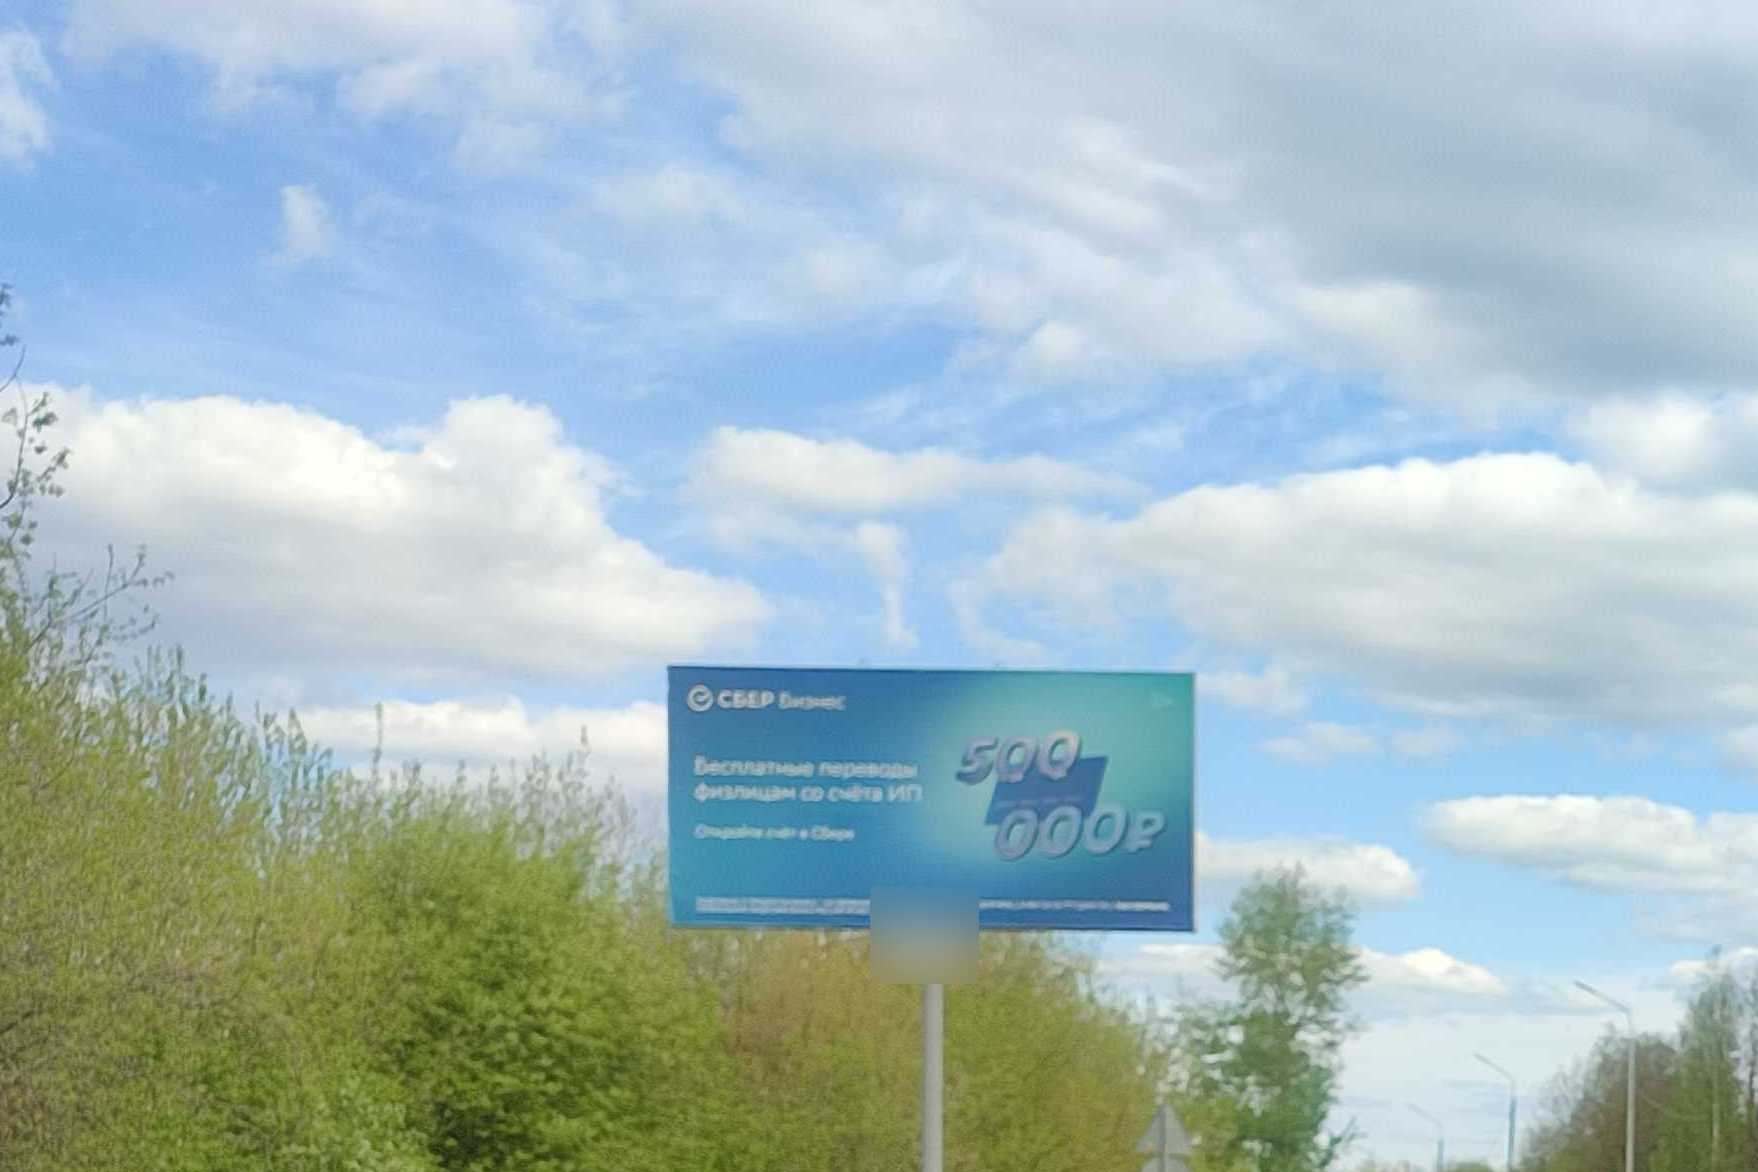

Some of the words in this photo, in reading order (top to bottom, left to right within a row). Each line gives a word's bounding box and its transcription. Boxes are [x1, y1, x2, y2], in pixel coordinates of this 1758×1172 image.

[716, 688, 775, 709] СБЕР
[955, 729, 1080, 785] 500
[800, 787, 825, 802] со
[888, 783, 923, 802] ИП
